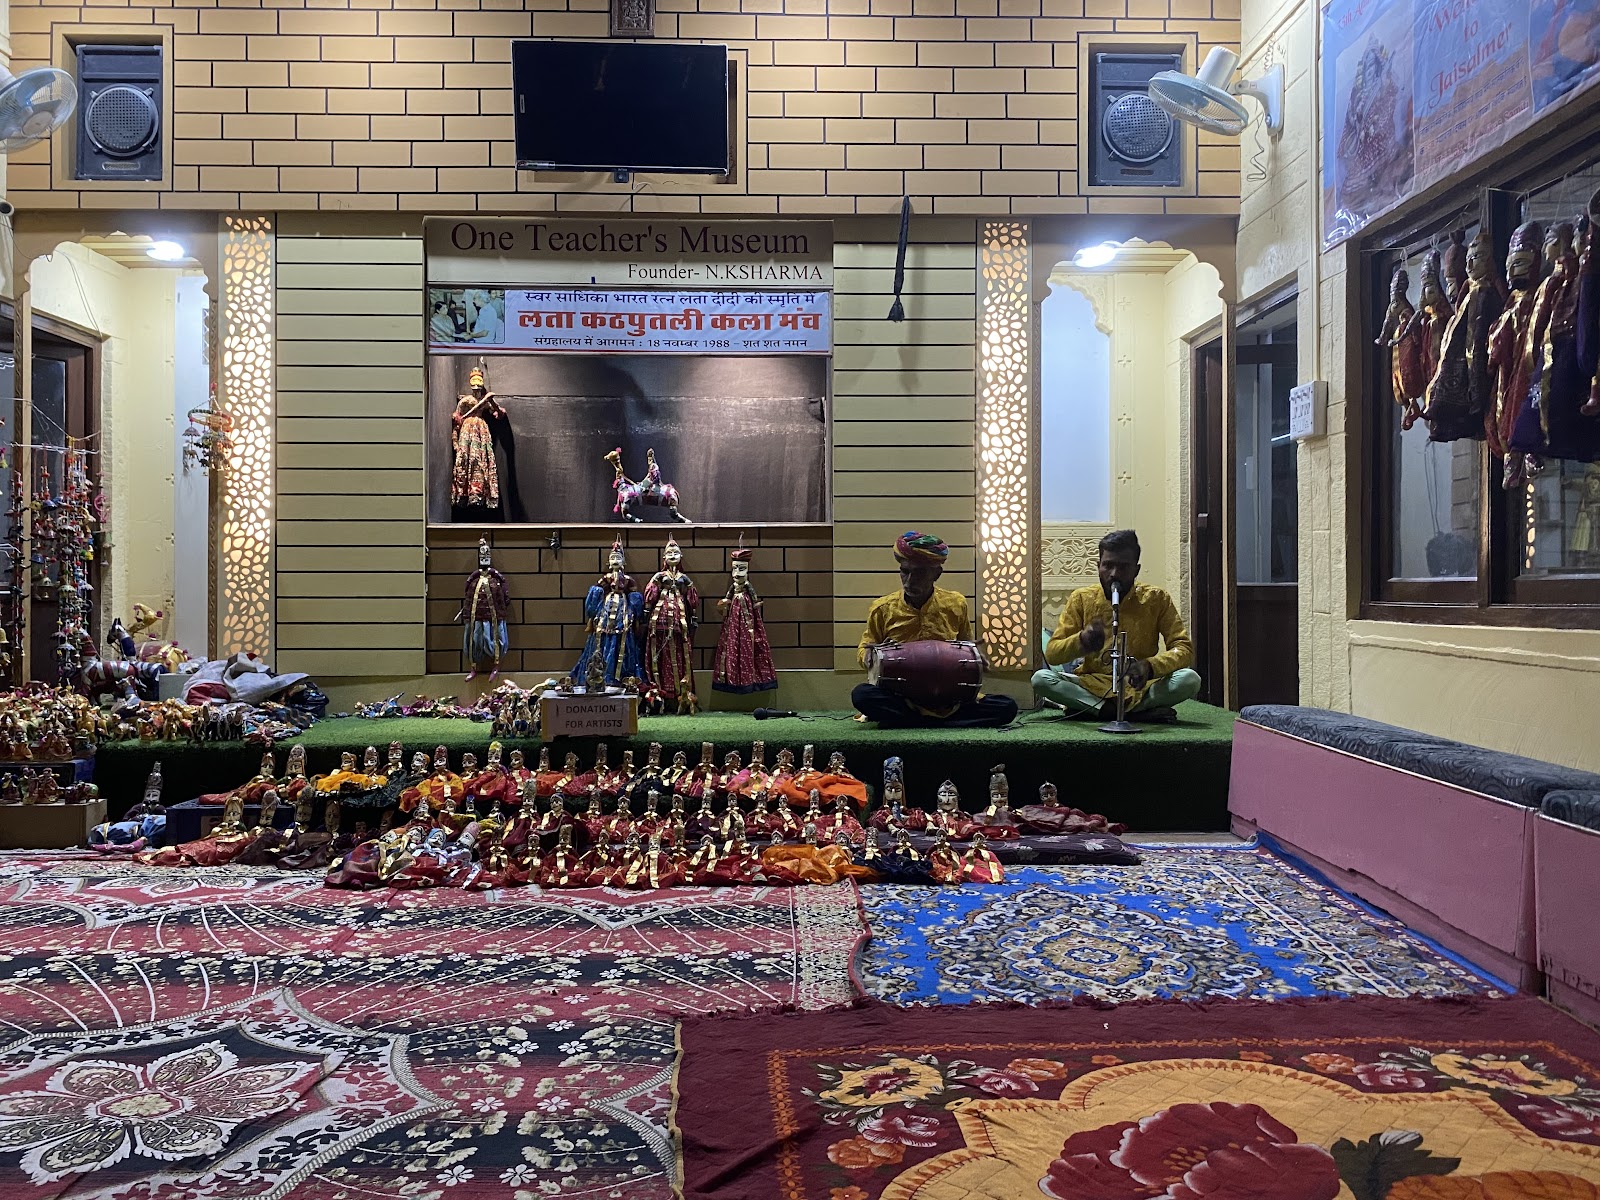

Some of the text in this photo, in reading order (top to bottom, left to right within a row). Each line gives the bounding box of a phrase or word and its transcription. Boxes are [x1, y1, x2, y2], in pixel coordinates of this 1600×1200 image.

[1464, 20, 1478, 42] to
[1428, 22, 1512, 109] Jaisalmer
[451, 222, 810, 254] One Teacher's Museum
[628, 264, 700, 280] Founder-
[525, 291, 552, 303] स्वर
[556, 290, 609, 303] साधिका
[613, 292, 648, 304] भारत
[651, 293, 676, 305] रत्न
[678, 294, 707, 305] लता
[711, 292, 740, 307] दीदी
[767, 292, 801, 308] स्मृति
[803, 291, 817, 305] में
[517, 307, 823, 337] लता कठपुतली कला मंच
[533, 335, 582, 346] संग्रहालय
[584, 335, 594, 346] में
[596, 338, 636, 347] आगमन
[649, 340, 661, 348] 18
[663, 339, 699, 349] नवम्बर
[703, 340, 730, 348] 1988
[743, 339, 760, 348] शत
[763, 339, 781, 348] शत
[784, 340, 808, 348] नमन
[565, 704, 617, 714] DONATION
[565, 719, 623, 729] FOR ARTISTS
